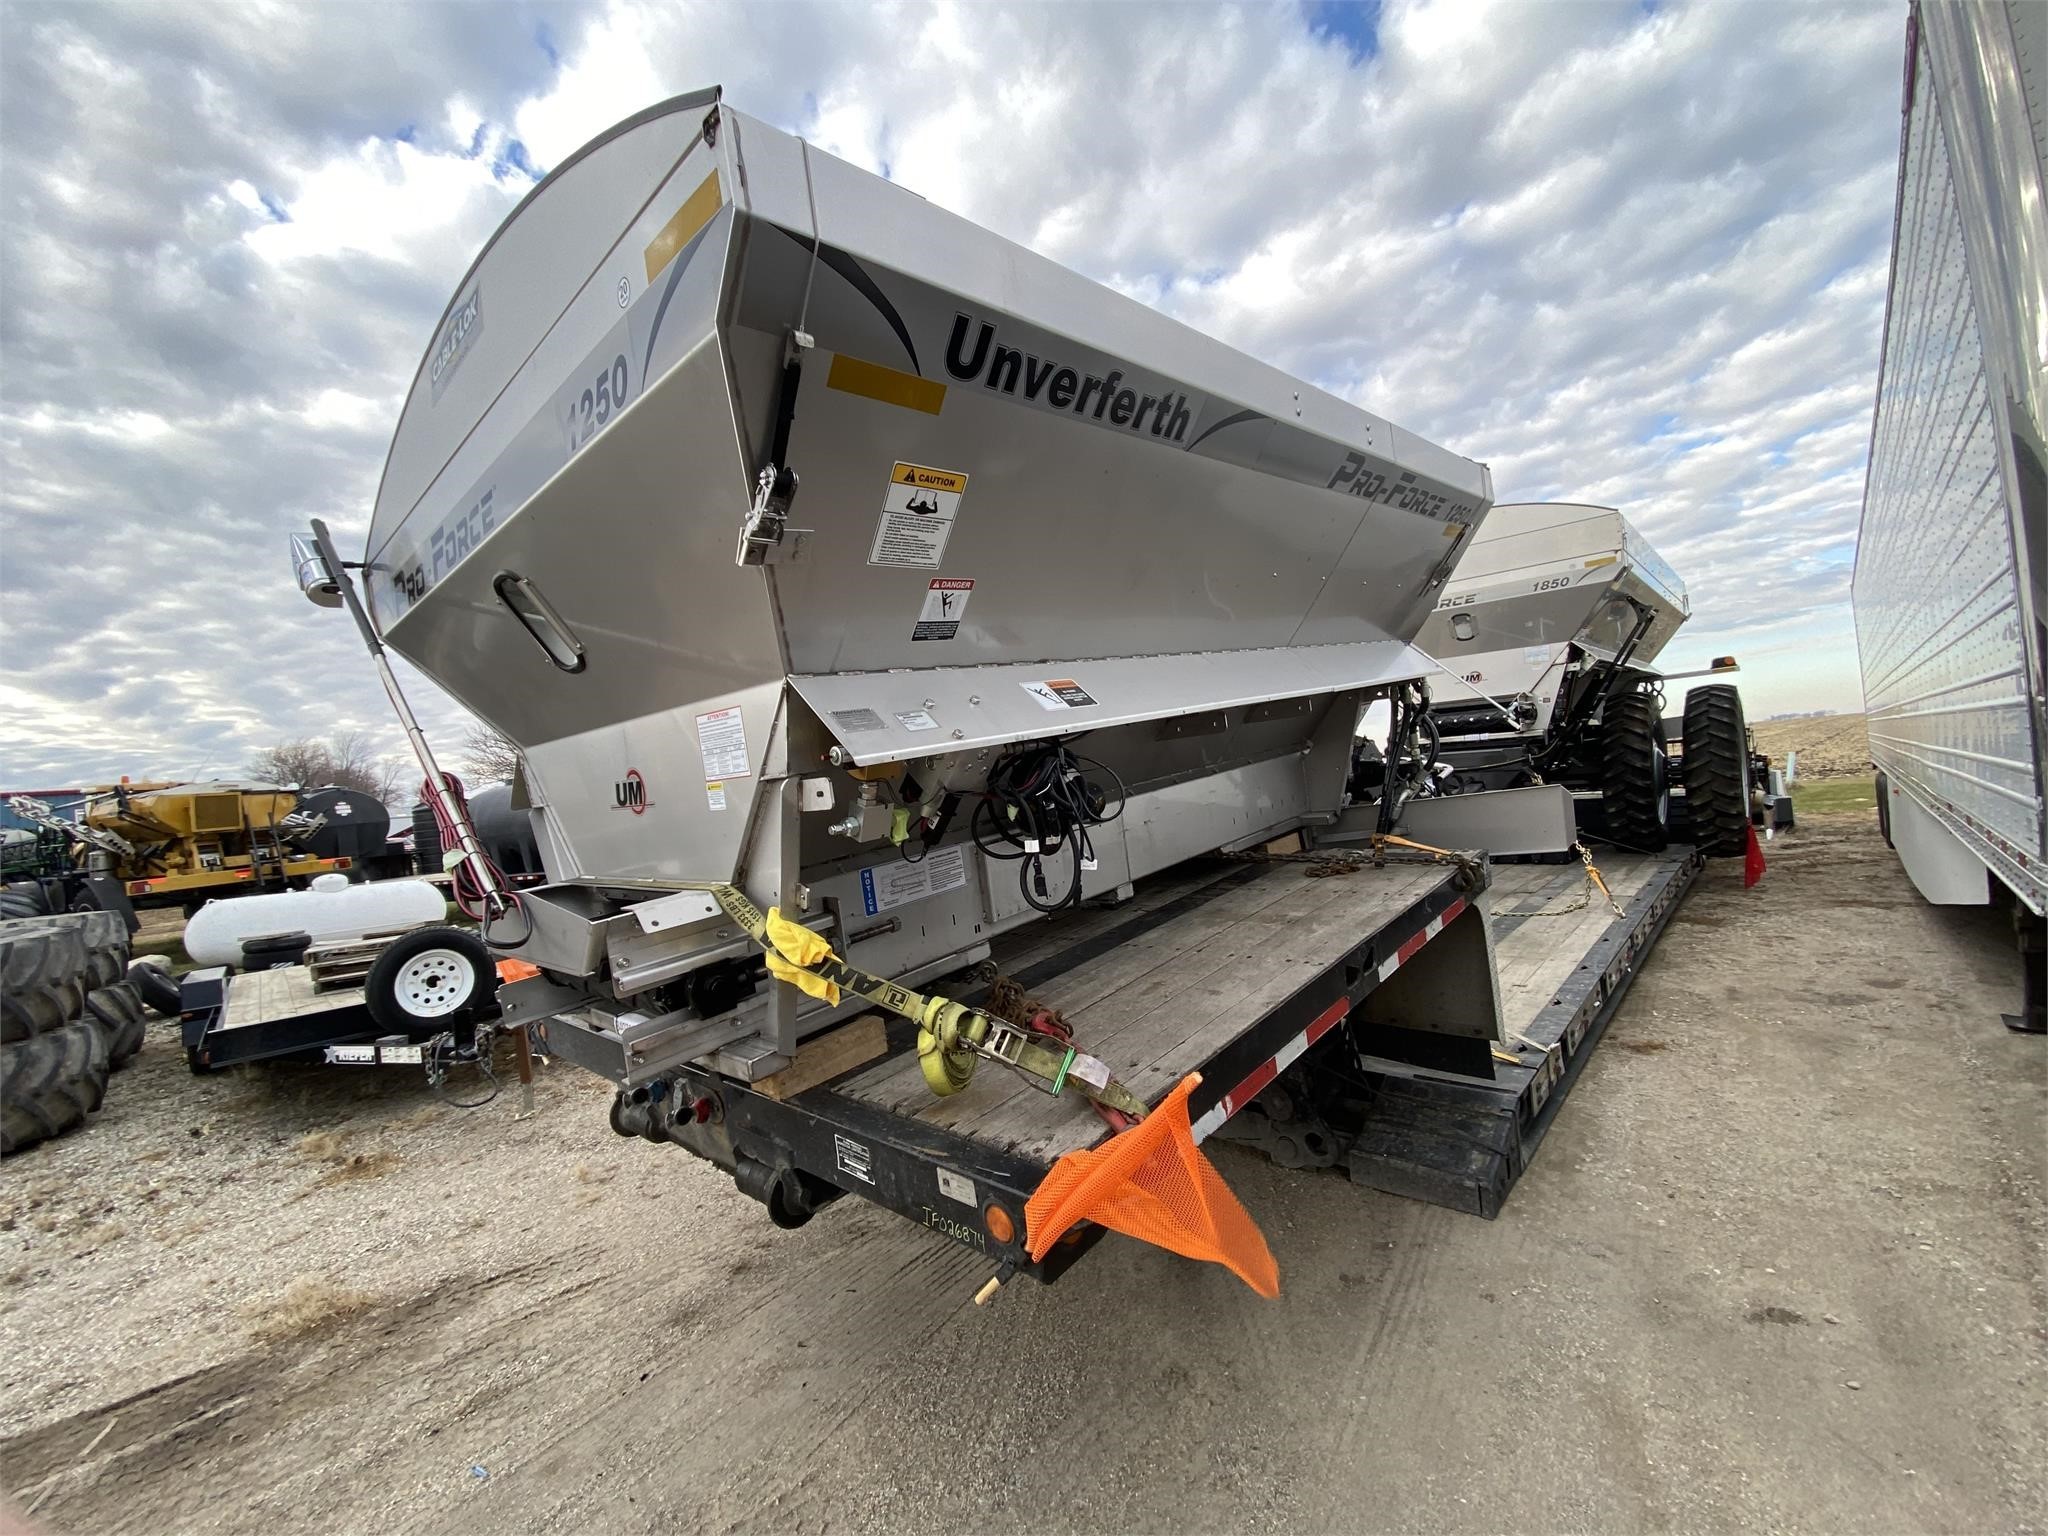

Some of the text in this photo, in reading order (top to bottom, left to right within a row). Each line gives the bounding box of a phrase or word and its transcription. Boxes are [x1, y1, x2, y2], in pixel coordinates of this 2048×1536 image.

[944, 311, 1192, 442] Unverferth
[566, 353, 628, 451] 1250
[918, 474, 956, 488] CAUTION
[941, 580, 971, 589] DANGER
[1532, 577, 1570, 592] 1850
[615, 780, 643, 806] UM
[863, 872, 875, 912] NOTICE
[725, 900, 742, 915] LBS
[735, 895, 762, 923] 1515 KGS
[737, 913, 755, 930] 3333
